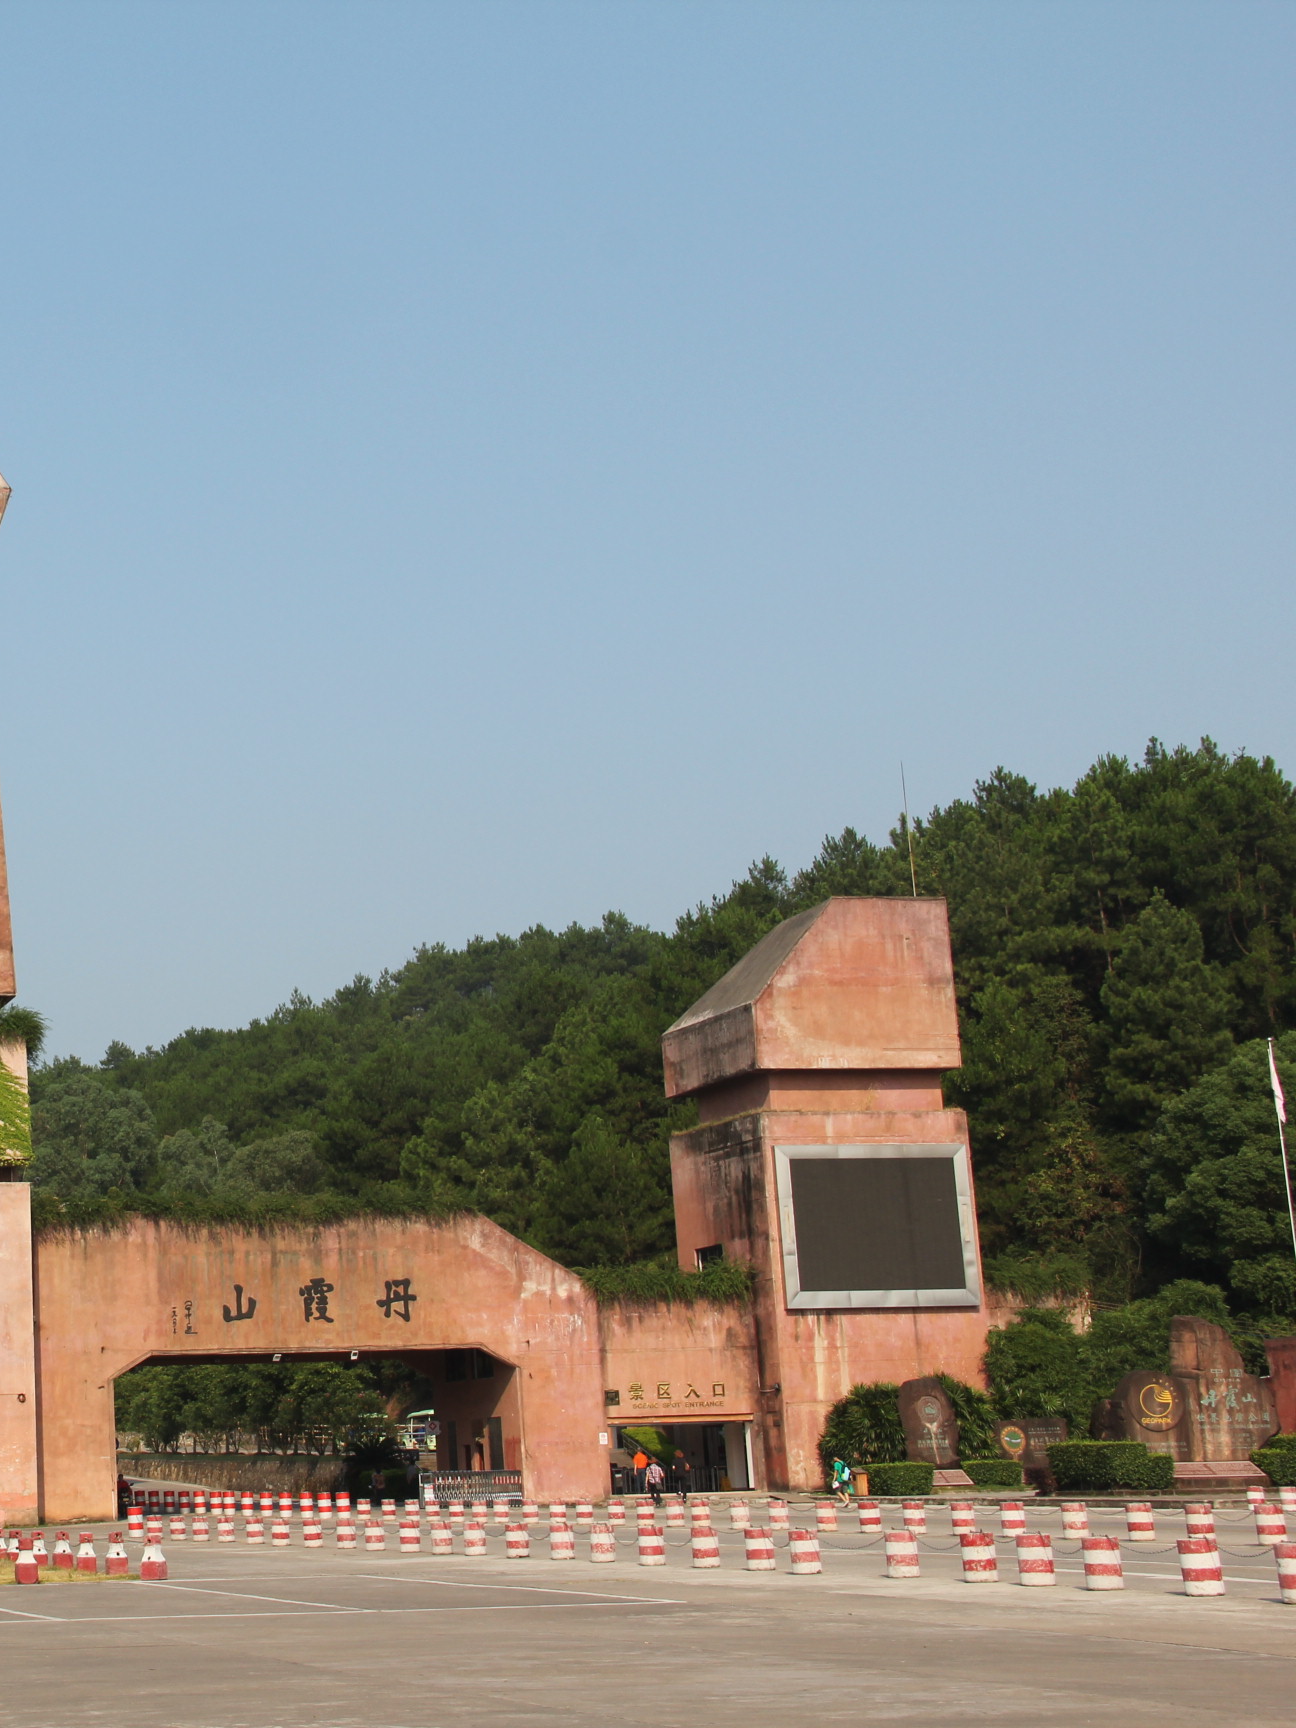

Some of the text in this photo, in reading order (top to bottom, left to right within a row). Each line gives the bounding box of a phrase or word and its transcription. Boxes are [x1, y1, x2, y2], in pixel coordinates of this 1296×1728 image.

[628, 1381, 726, 1401] 景区入口
[632, 1400, 724, 1410] SCENIC SPOT ENTRANCE
